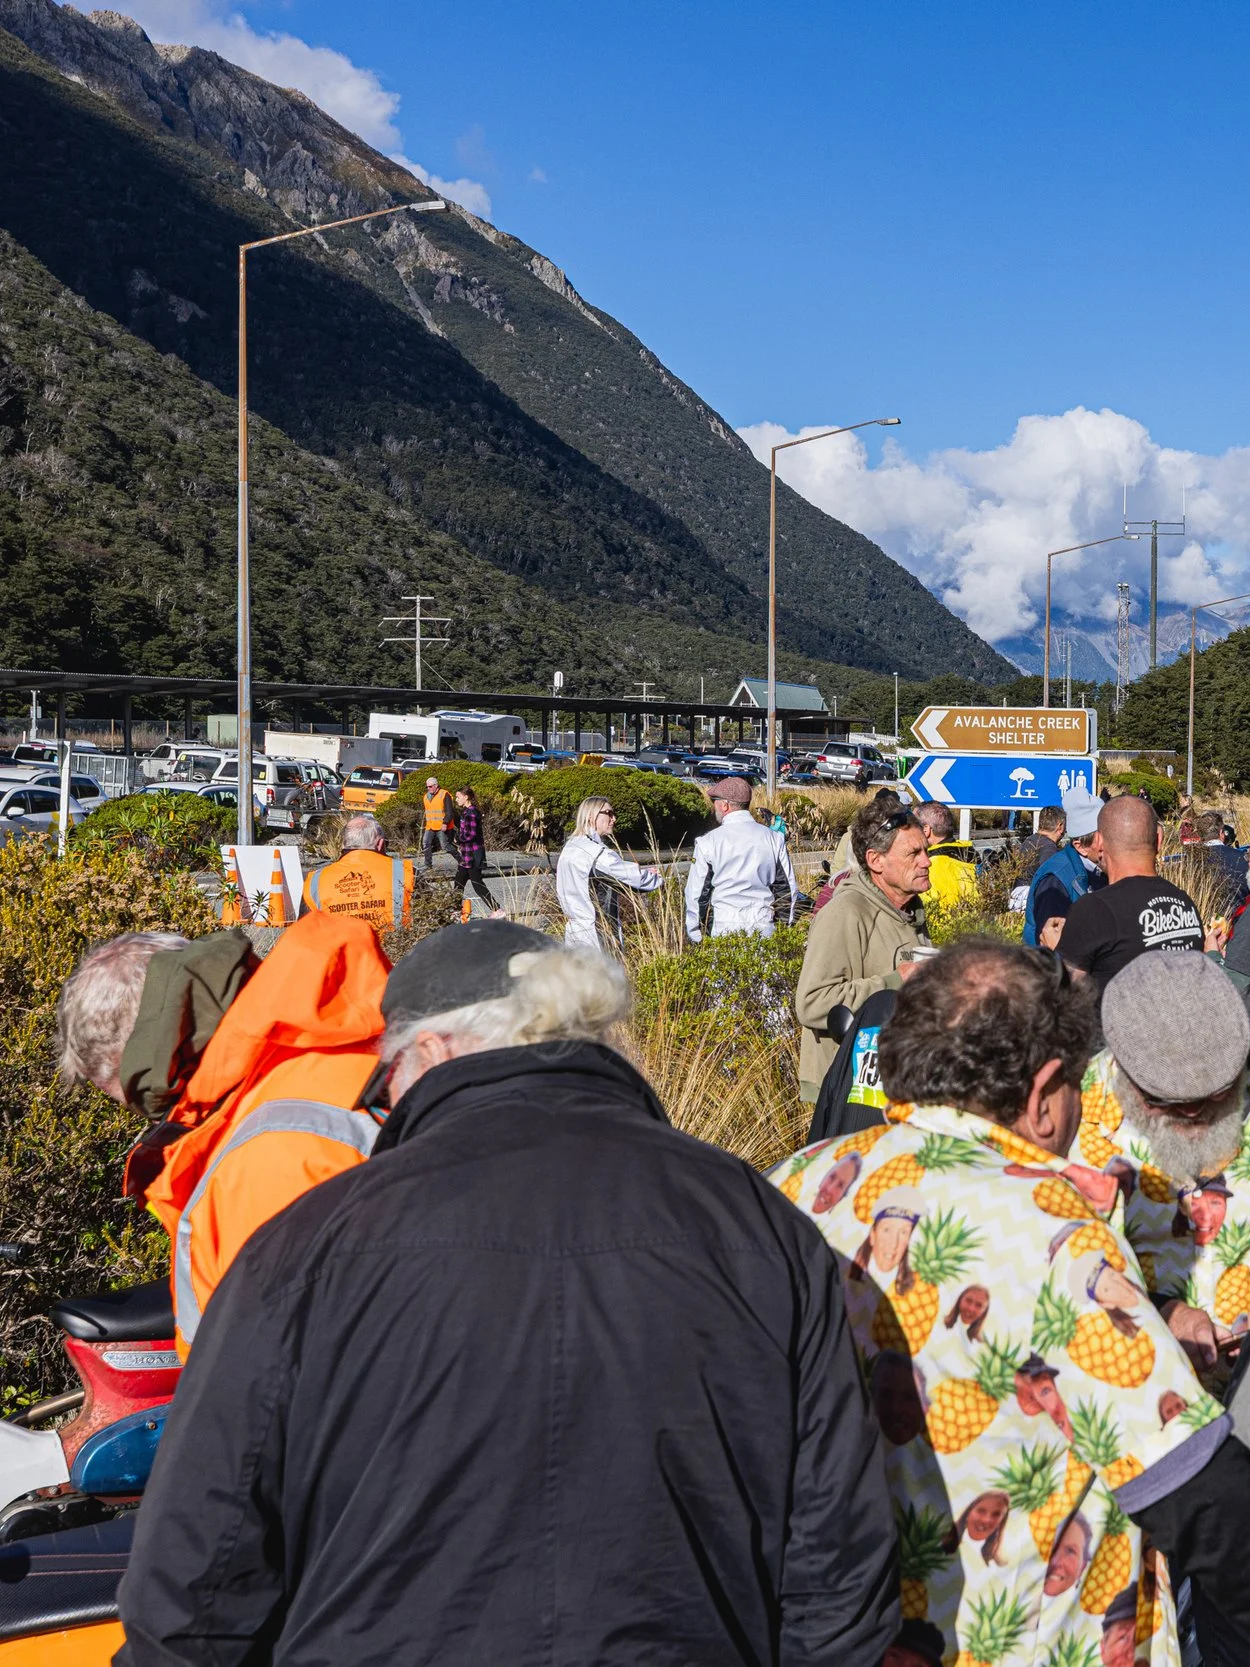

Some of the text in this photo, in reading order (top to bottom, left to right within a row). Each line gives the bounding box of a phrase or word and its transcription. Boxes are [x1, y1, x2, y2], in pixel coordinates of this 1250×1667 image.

[954, 716, 1080, 730] AVALANCHE CREEK
[988, 732, 1045, 745] SHELTER
[328, 899, 386, 913] SCOOTER SAFARI
[1147, 896, 1186, 908] MOTORCYCLE
[1138, 904, 1200, 937] BikeShed
[1161, 940, 1194, 952] COMPANY
